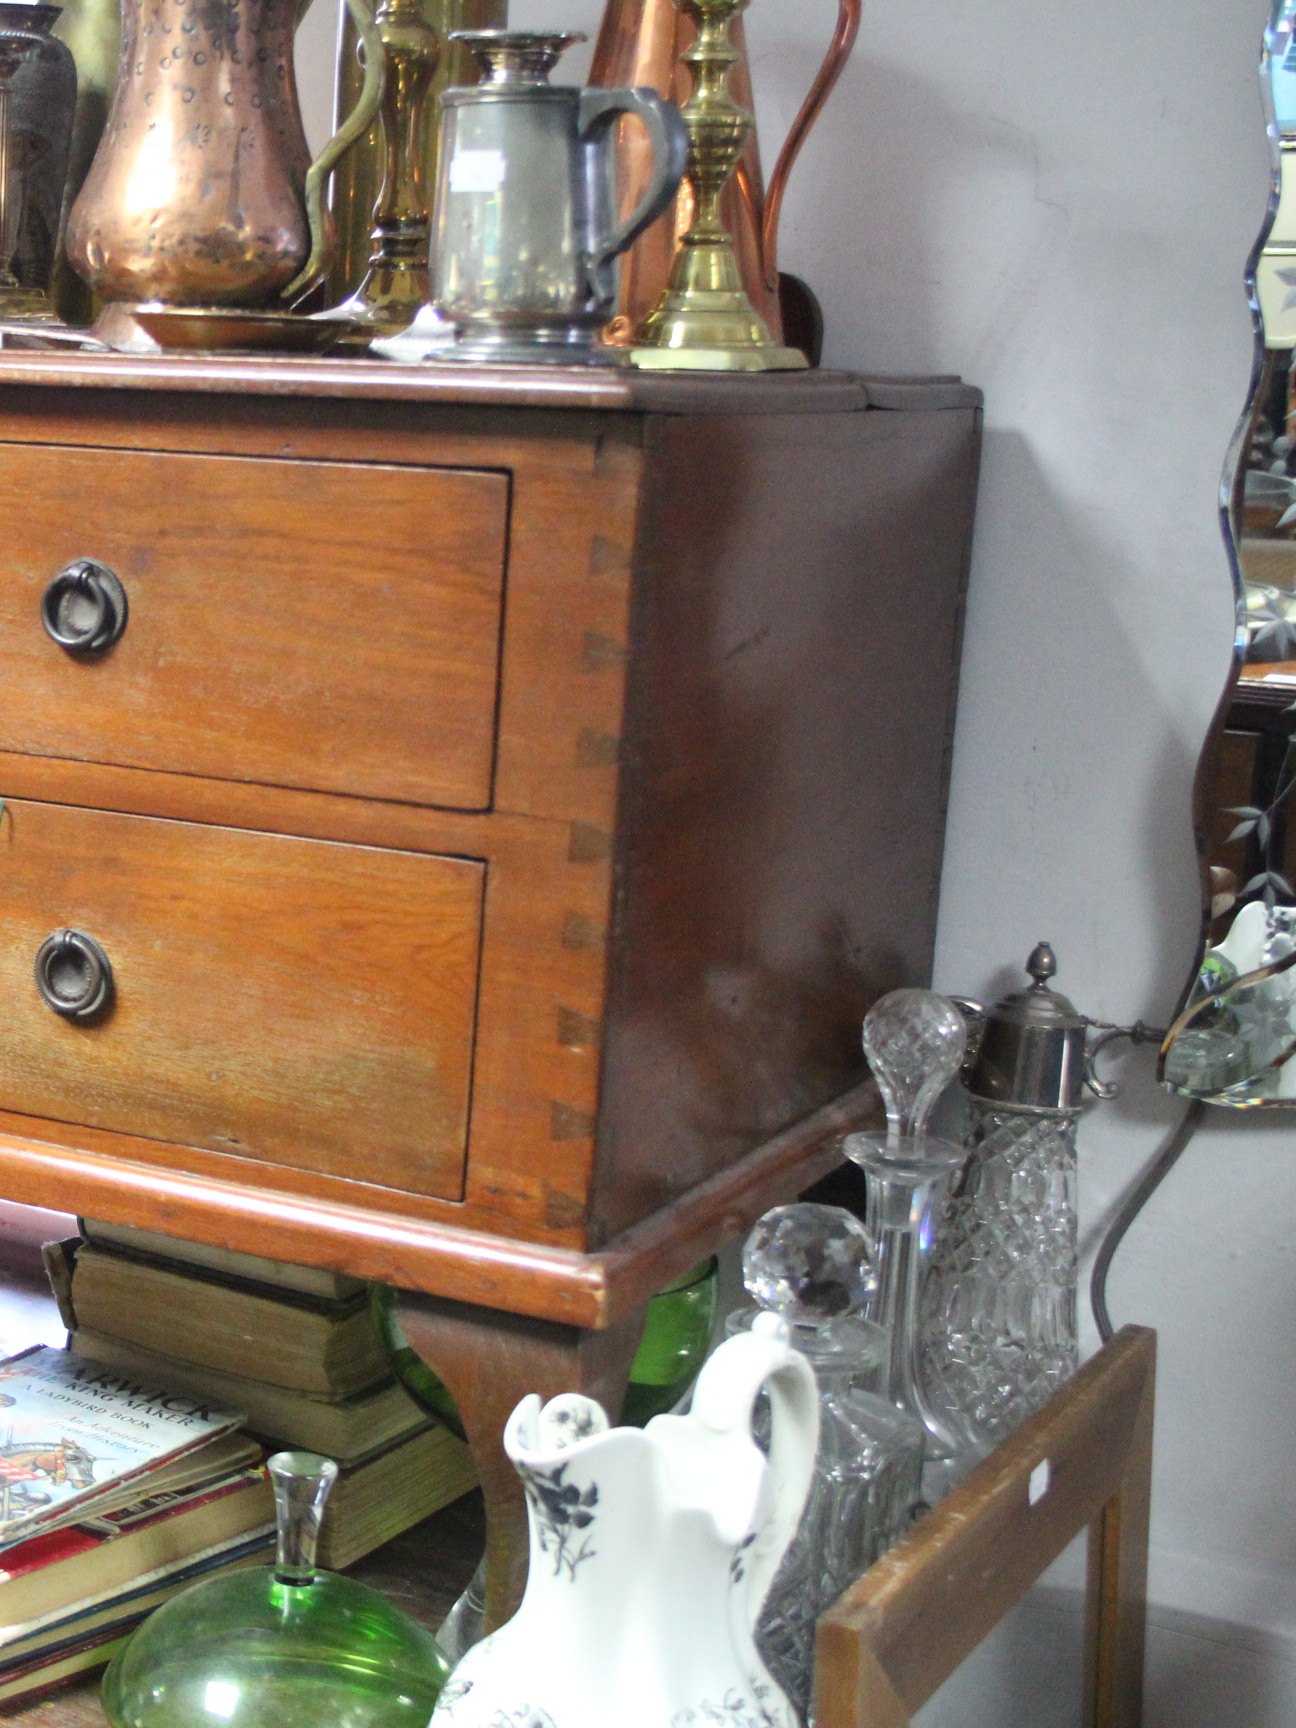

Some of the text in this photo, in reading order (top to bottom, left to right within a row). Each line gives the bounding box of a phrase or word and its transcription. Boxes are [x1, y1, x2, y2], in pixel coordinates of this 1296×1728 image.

[33, 1387, 108, 1415] LADYBIRD
[109, 1409, 151, 1430] BOOK
[64, 1377, 119, 1403] KING
[125, 1398, 195, 1428] MAKER
[65, 1414, 87, 1425] An
[82, 1427, 140, 1455] History
